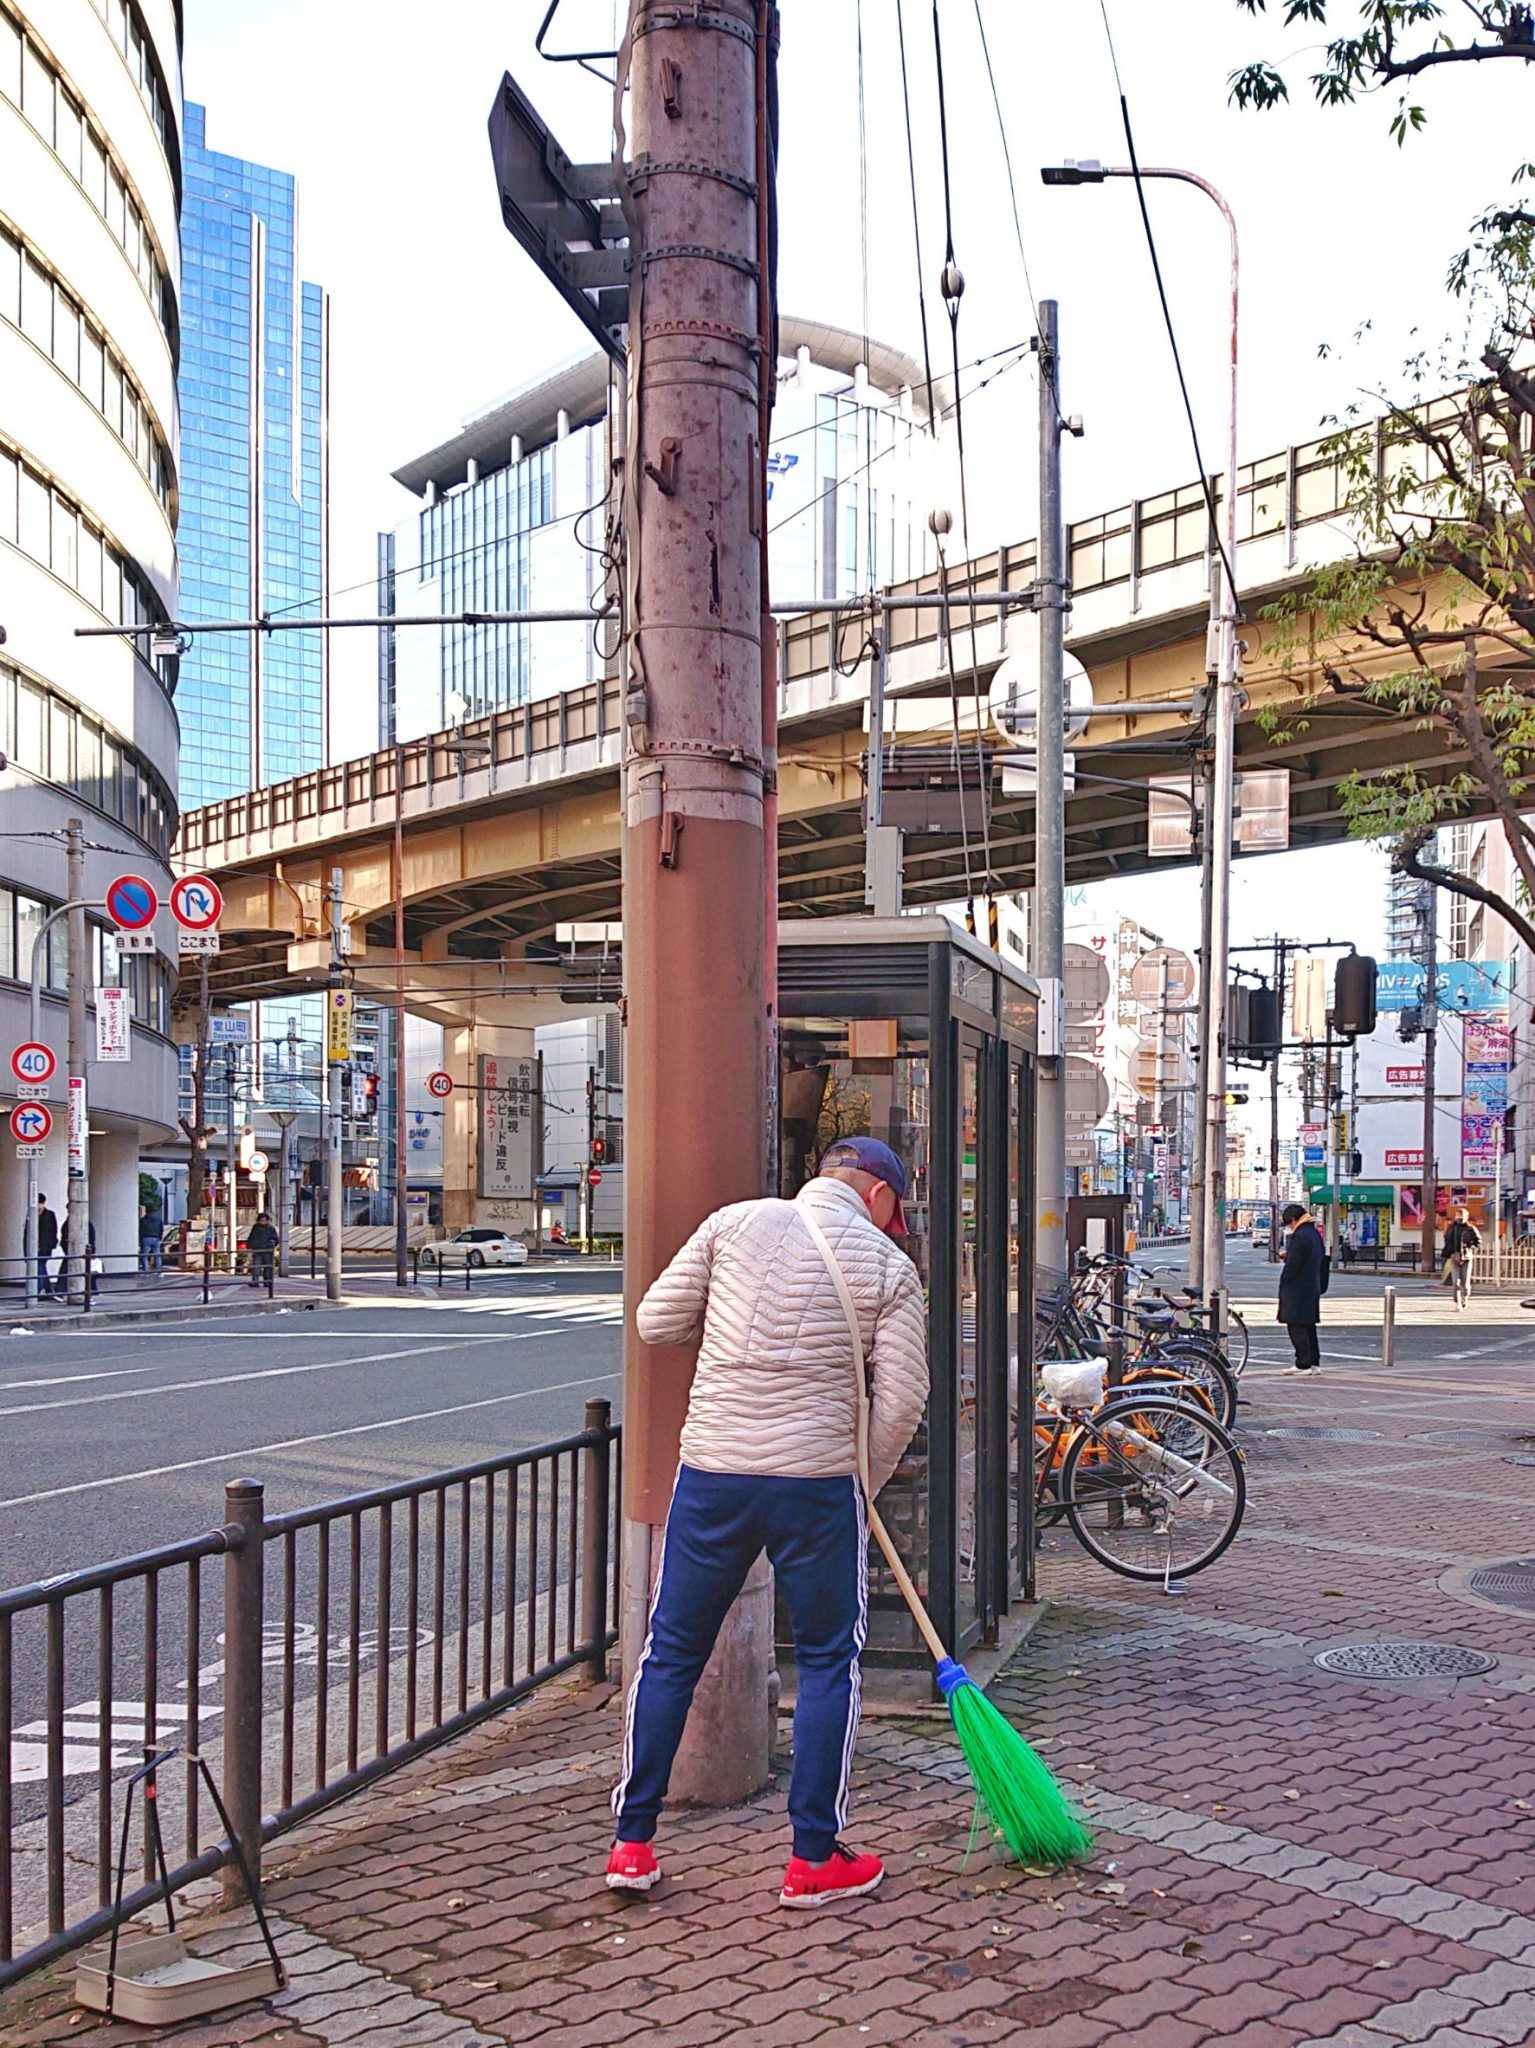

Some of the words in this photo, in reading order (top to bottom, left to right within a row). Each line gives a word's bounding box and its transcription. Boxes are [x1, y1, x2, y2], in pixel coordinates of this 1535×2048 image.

[116, 936, 154, 948] 自動車
[180, 936, 217, 948] ここまで
[21, 1054, 46, 1072] 40
[434, 1078, 448, 1091] 40
[519, 1063, 530, 1117] 飲酒運転
[18, 1087, 48, 1097] ここまで
[507, 1076, 519, 1133] 信号無視
[17, 1148, 45, 1157] ここまで
